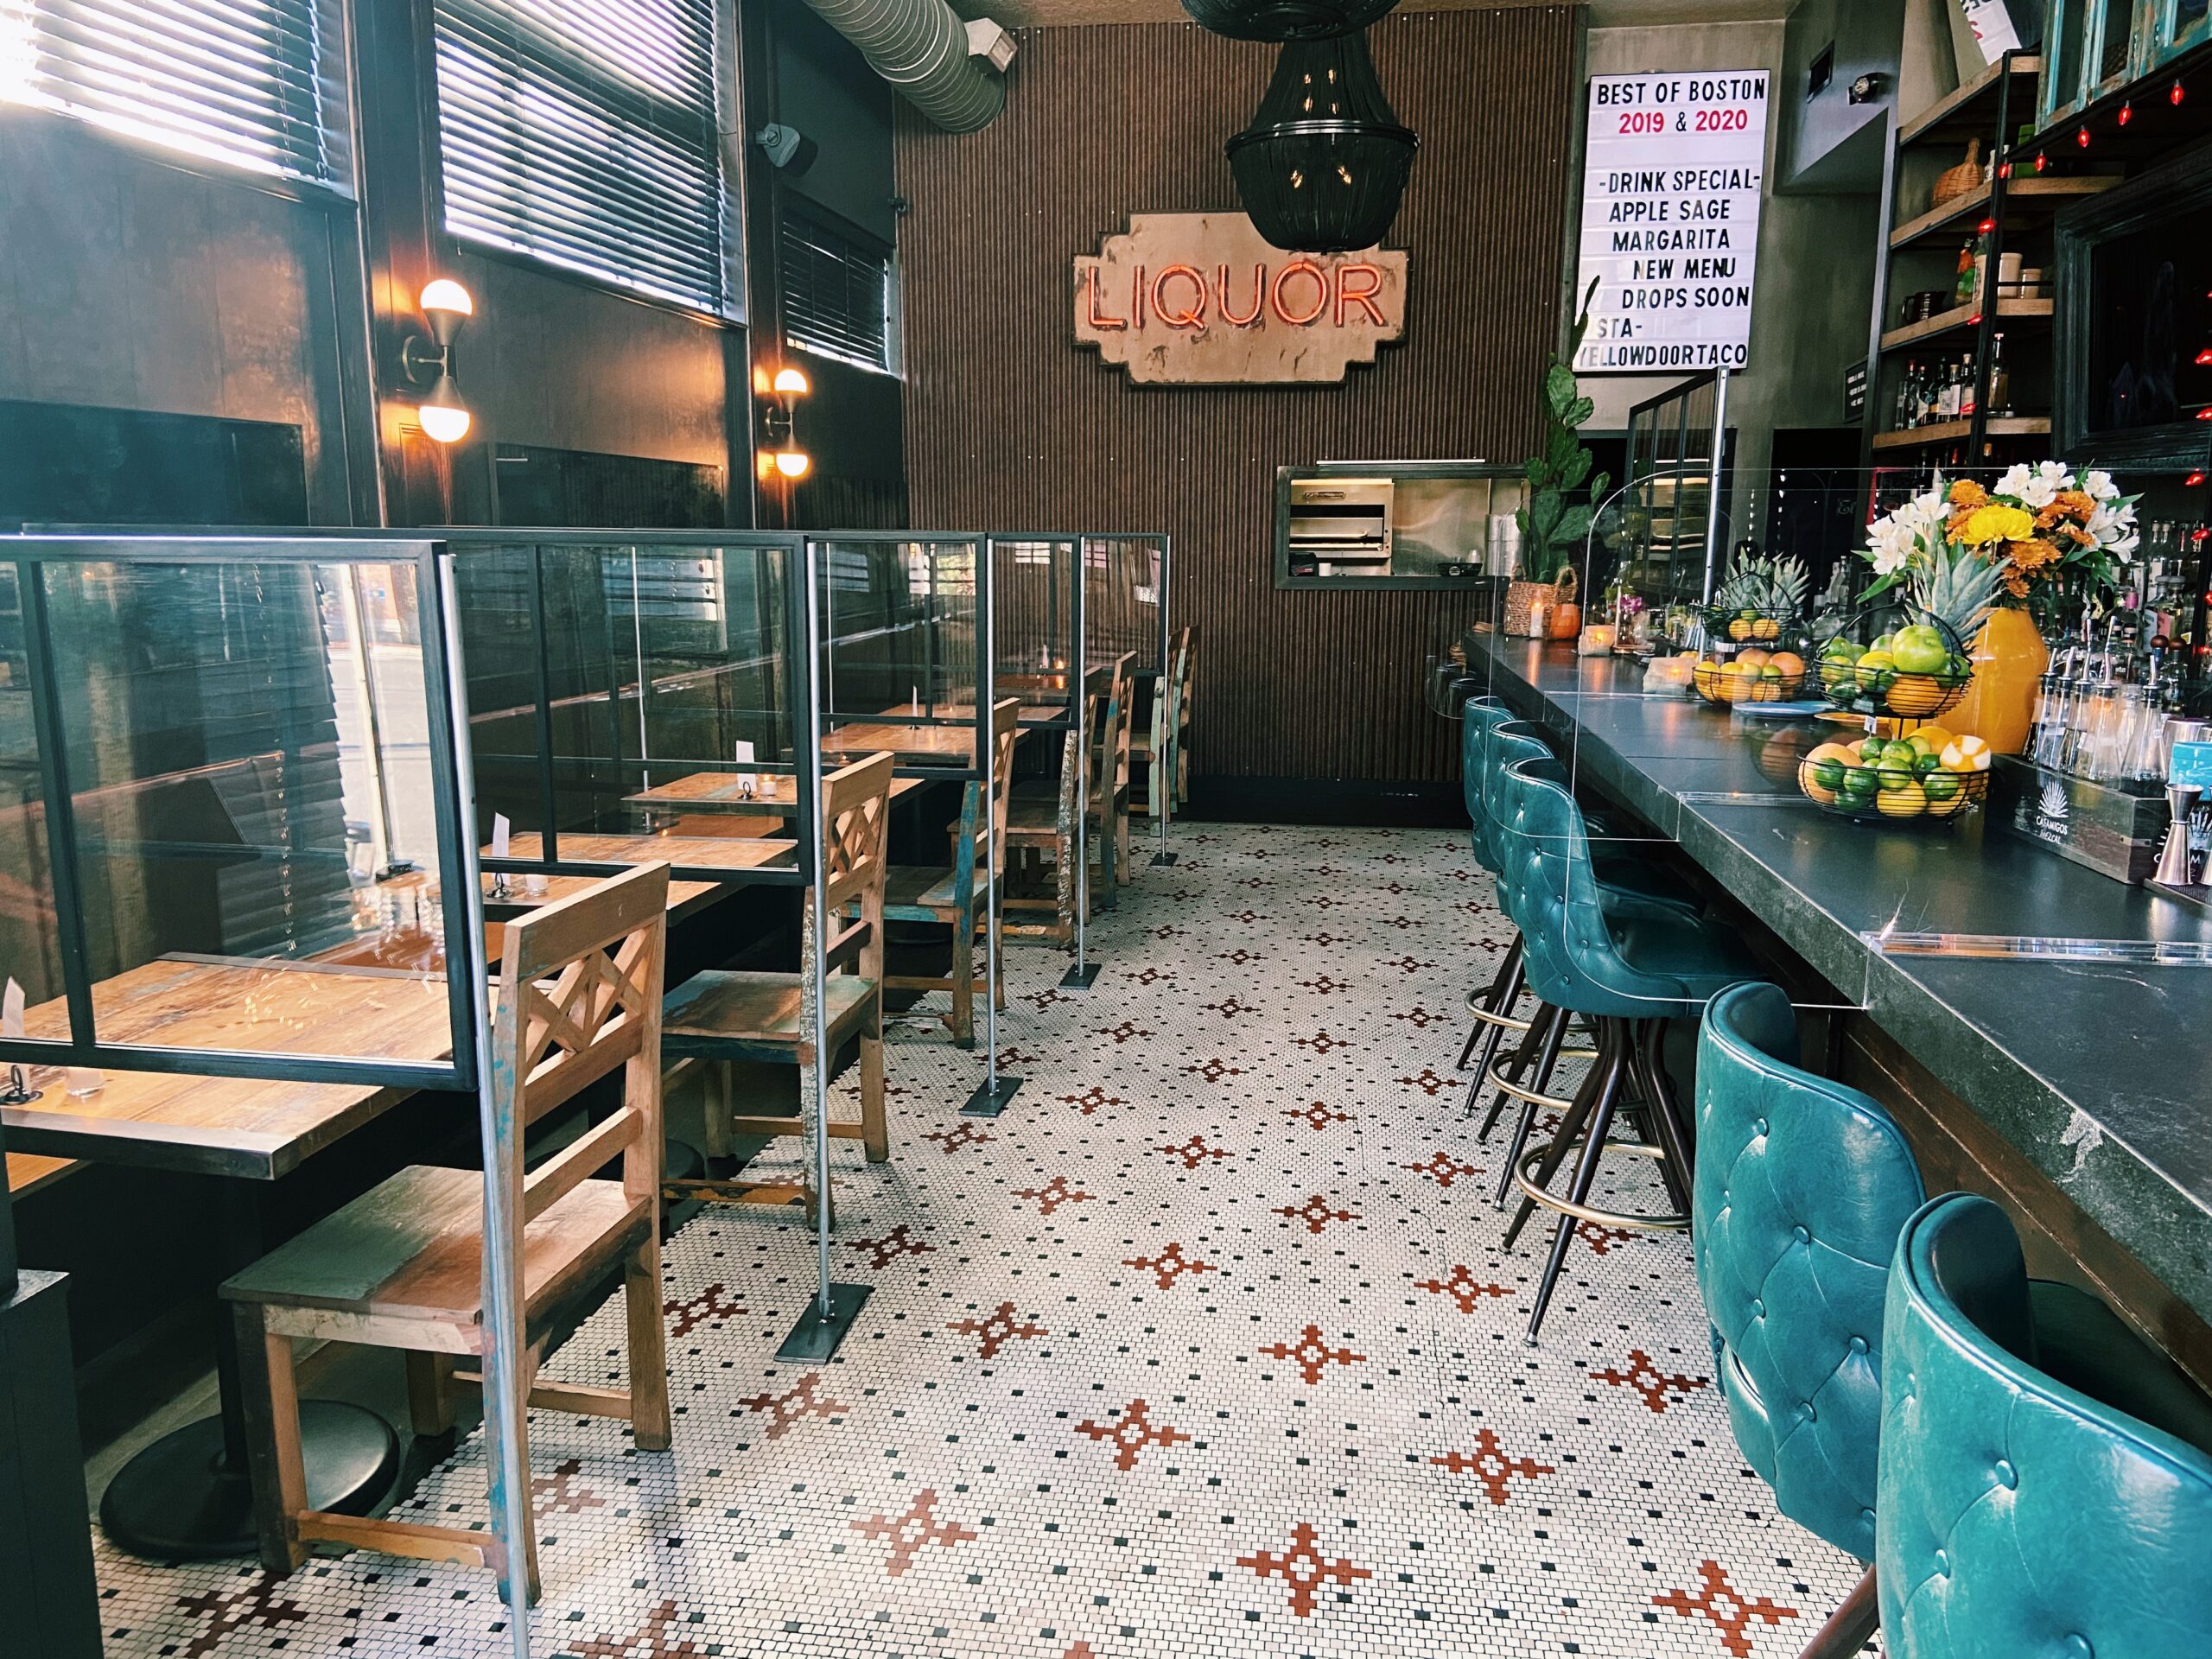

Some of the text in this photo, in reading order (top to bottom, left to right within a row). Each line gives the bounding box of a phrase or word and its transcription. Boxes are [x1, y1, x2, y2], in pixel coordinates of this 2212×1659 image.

[1598, 78, 1765, 105] BEST OF BOSTON
[1618, 109, 1748, 134] 2019 & 2020
[1609, 199, 1731, 223] APPLE SAGE
[1612, 228, 1731, 251] MARGARITA
[1633, 257, 1736, 280] NEW MENU
[1088, 261, 1386, 329] LIQUOR
[1622, 286, 1750, 309] DROPS SOON
[2036, 815, 2068, 836] CASAMIGOS
